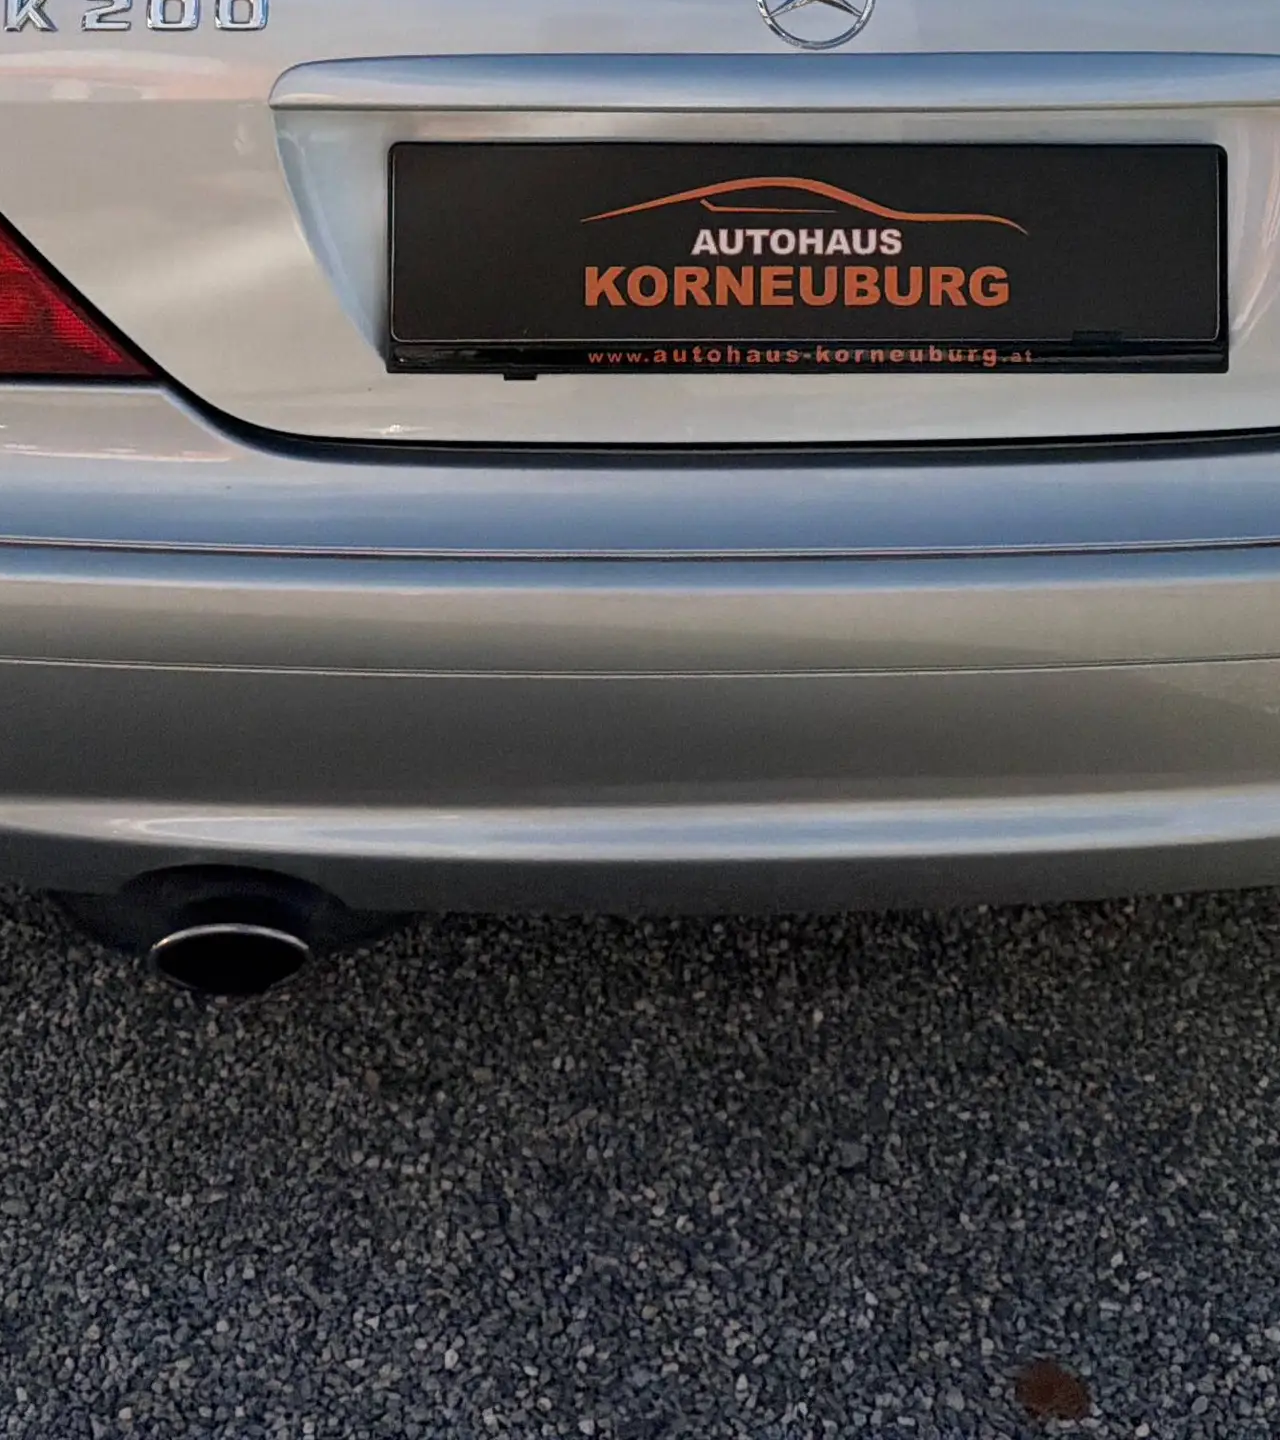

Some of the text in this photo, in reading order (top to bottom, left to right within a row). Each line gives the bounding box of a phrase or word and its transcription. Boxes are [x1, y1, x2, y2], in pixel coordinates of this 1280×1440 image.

[690, 227, 903, 256] AUTOHAUS
[583, 265, 1010, 307] KORNEUBURG
[587, 344, 1034, 368] www.autohaus-korneuburg.at
